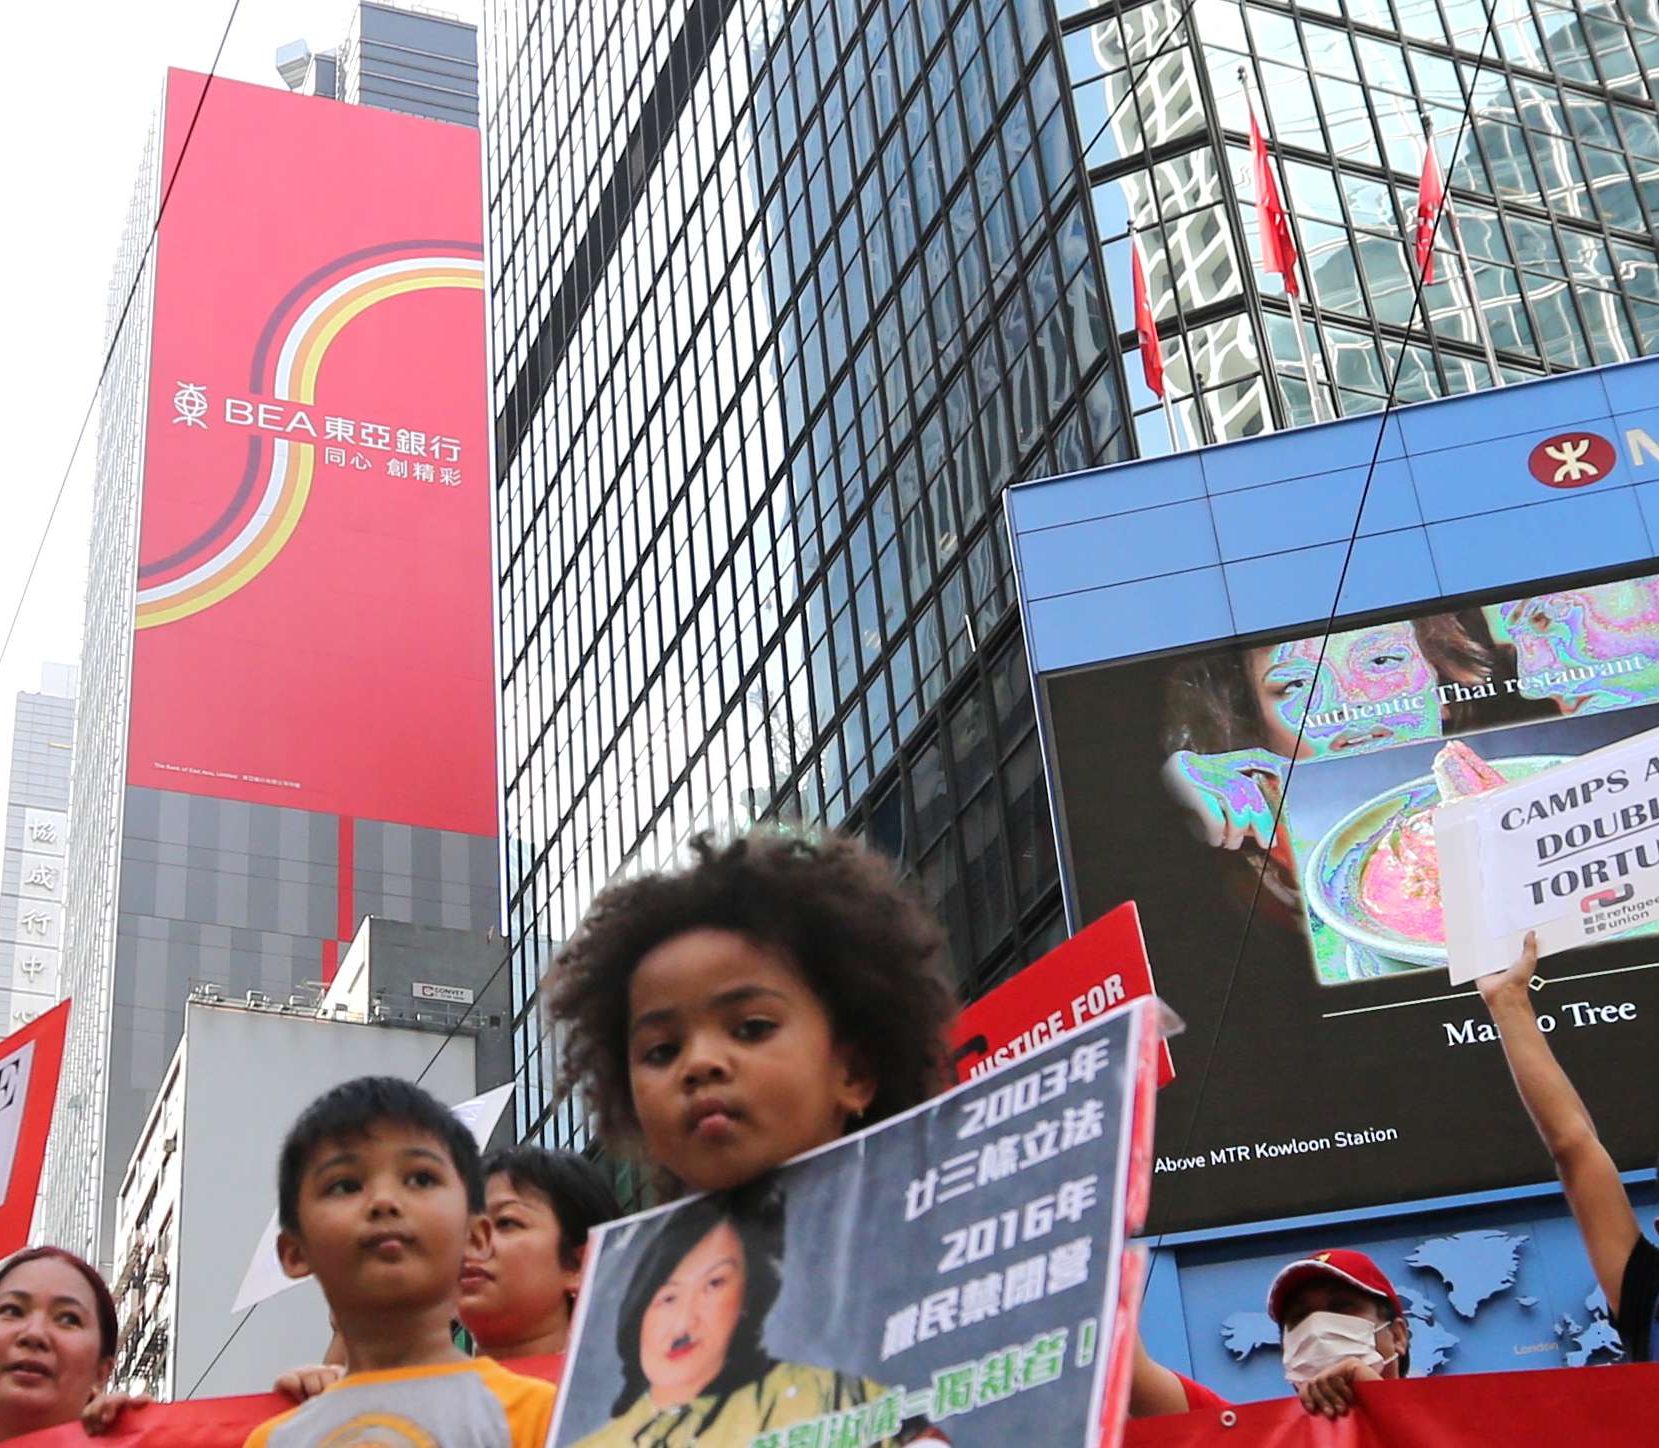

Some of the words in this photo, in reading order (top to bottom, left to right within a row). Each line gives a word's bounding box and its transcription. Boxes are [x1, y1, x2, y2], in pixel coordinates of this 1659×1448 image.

[224, 398, 317, 438] BEA
[323, 415, 462, 463] 東亞銀行
[324, 446, 373, 471] 同心
[386, 457, 462, 488] 創精彩
[1435, 676, 1497, 706] Thai
[1506, 656, 1645, 694] restaurant
[1500, 769, 1630, 832] CAMPS
[1608, 910, 1650, 929] union
[1070, 973, 1126, 1027] FOR
[1443, 1014, 1557, 1047] Mao
[1562, 1001, 1638, 1028] Tree
[957, 1038, 1110, 1141] 2003年
[904, 1097, 1105, 1223] 廿三條立法
[1154, 1155, 1206, 1174] Above
[1210, 1146, 1251, 1166] MTR
[1255, 1137, 1331, 1159] Kowloon
[1334, 1126, 1398, 1149] Station
[937, 1174, 1098, 1275] 2016年
